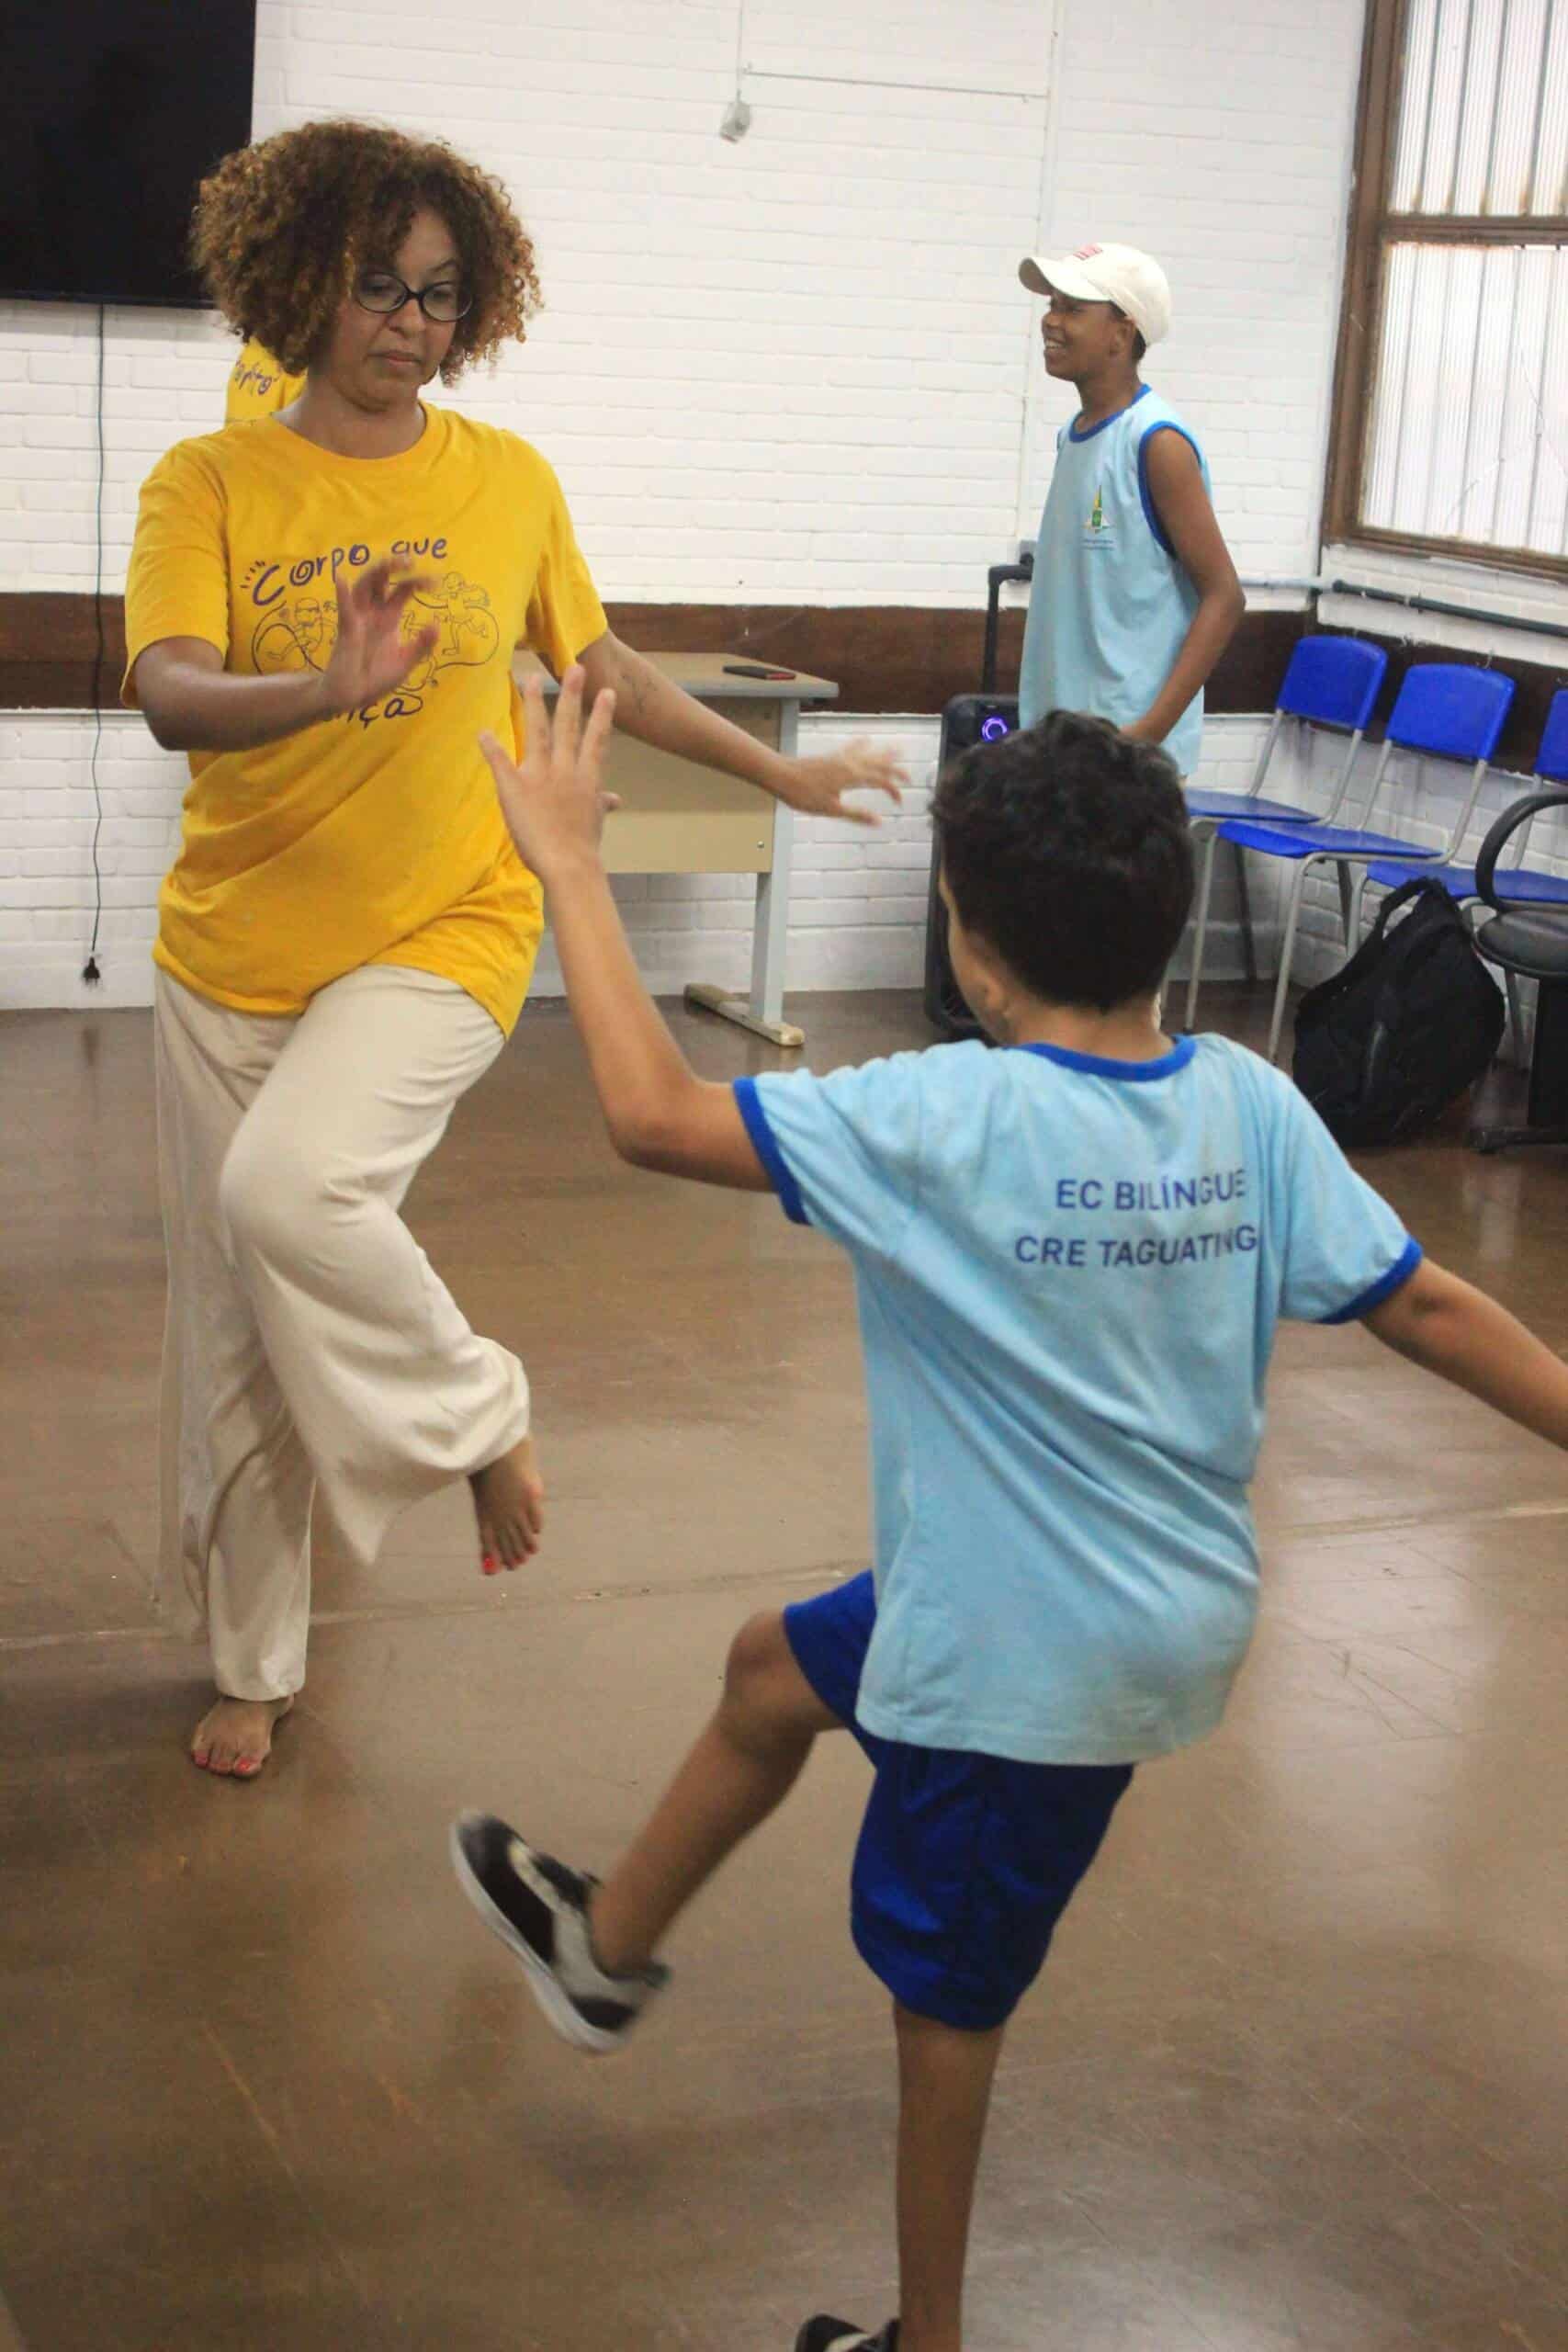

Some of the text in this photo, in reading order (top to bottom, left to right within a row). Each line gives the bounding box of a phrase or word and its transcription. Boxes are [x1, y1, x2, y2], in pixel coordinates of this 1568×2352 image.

[252, 544, 370, 606] Corpo
[1056, 1169, 1246, 1210] EC BILÍNGUE
[1015, 1236, 1087, 1266] CRE
